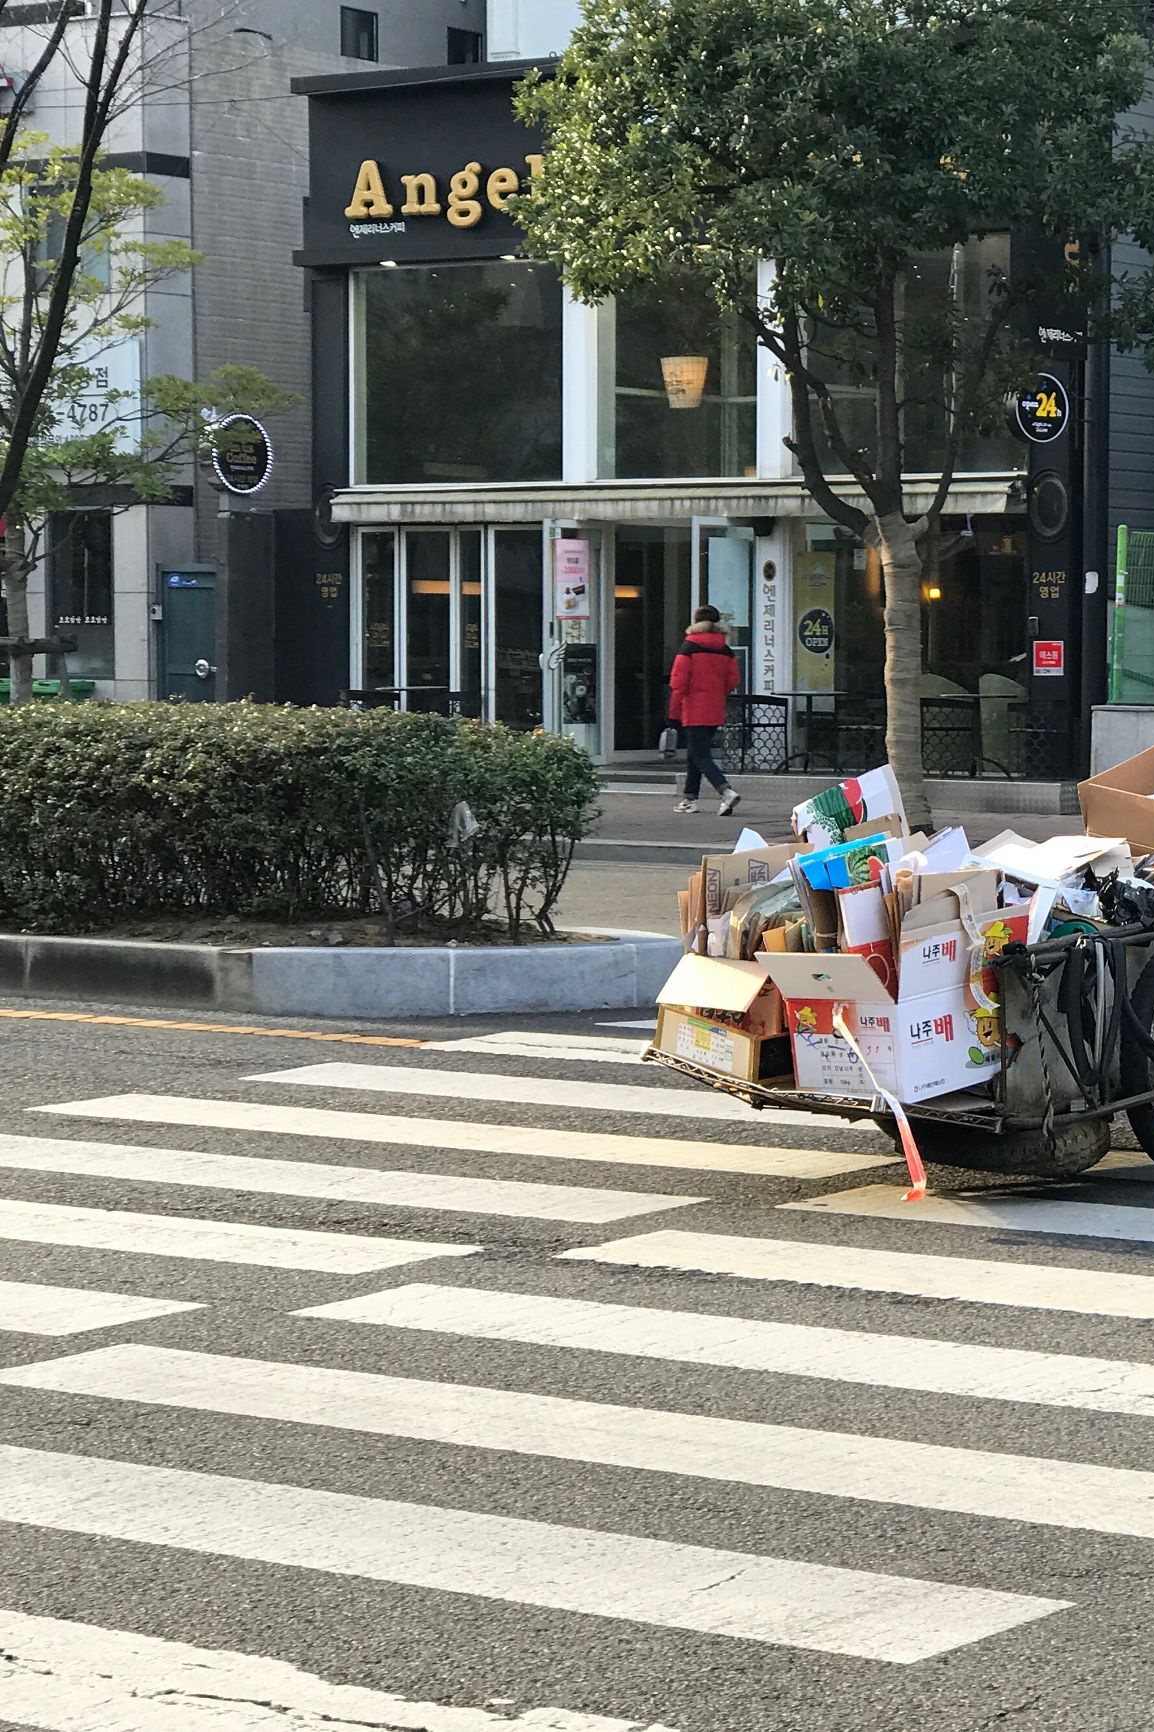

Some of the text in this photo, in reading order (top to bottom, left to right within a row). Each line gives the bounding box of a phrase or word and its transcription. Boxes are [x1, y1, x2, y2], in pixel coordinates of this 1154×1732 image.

[1032, 571, 1067, 584] 24시간
[1039, 586, 1060, 599] 영업
[762, 584, 777, 695] 엔제리너스커피
[806, 637, 829, 647] OPEN
[922, 939, 957, 962] 나주배
[859, 1015, 891, 1033] 나주배
[909, 1013, 955, 1042] 나주배
